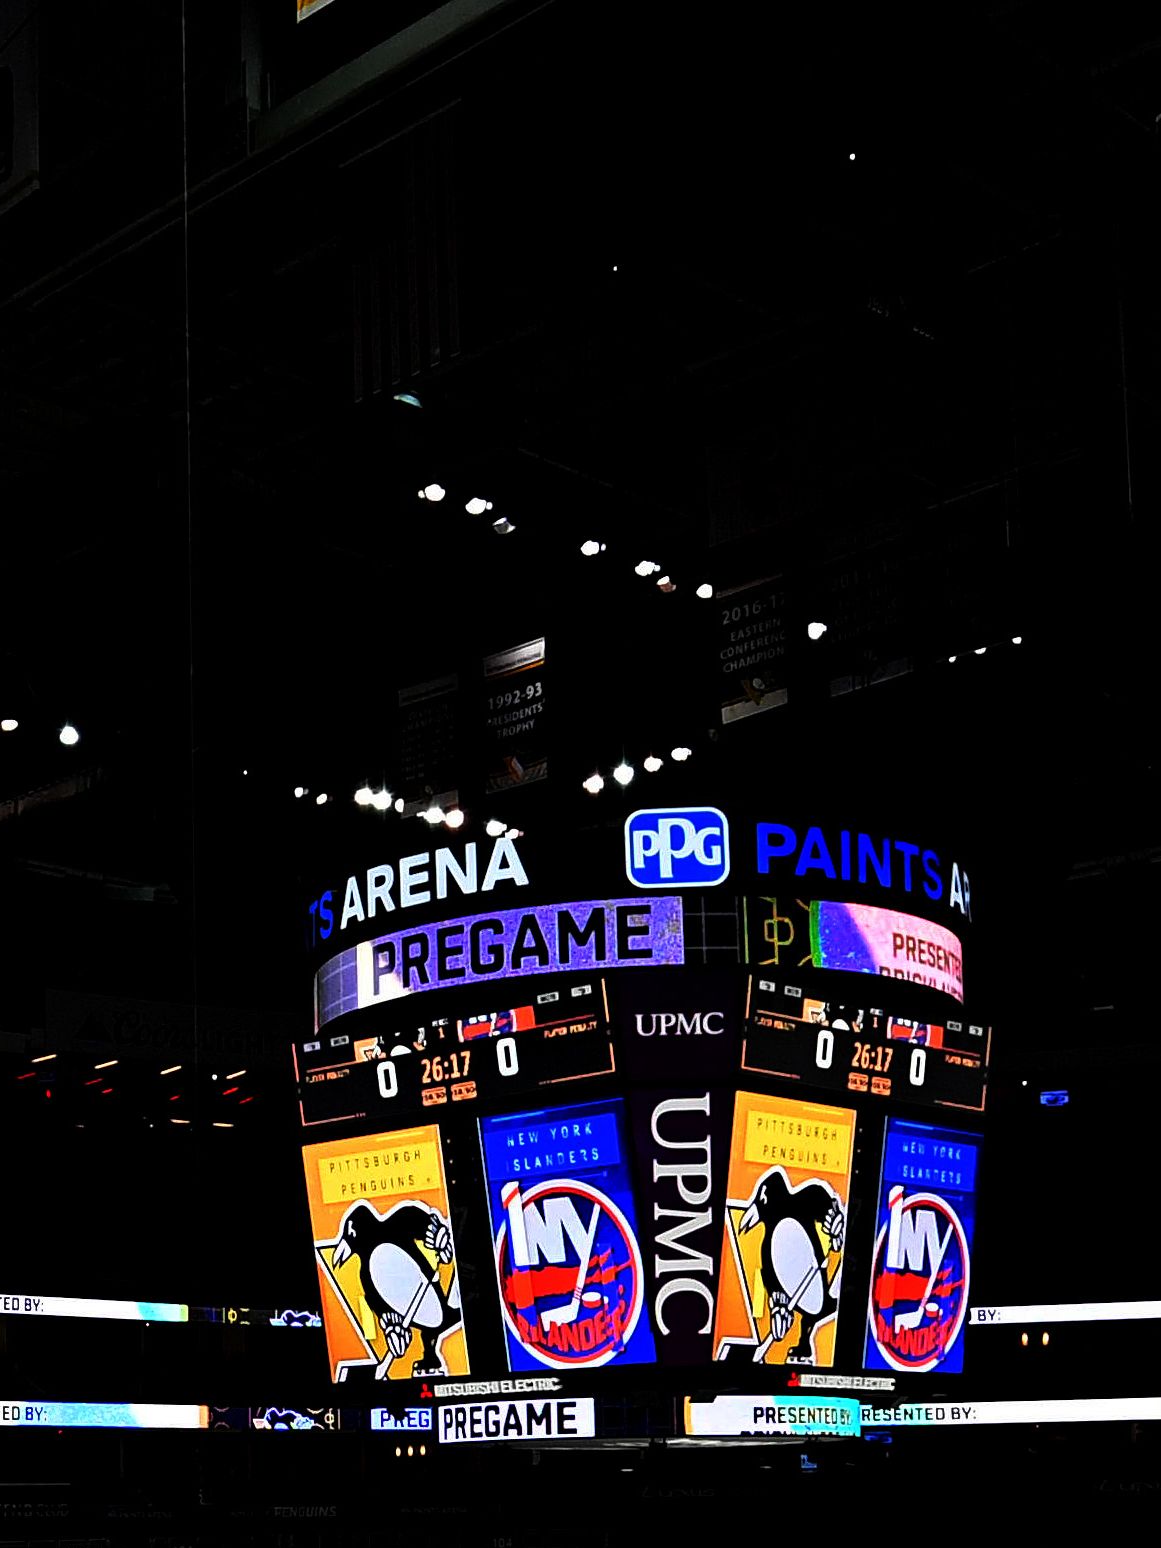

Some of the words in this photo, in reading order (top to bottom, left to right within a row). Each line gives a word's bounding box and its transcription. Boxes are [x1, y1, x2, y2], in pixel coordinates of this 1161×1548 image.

[720, 631, 787, 661] CONFERENC
[488, 682, 543, 710] 1992-93
[632, 819, 723, 879] PPG
[756, 823, 942, 900] PAINTS
[340, 837, 529, 930] ARENA
[372, 904, 653, 996] PREGAME
[633, 1010, 724, 1037] UPMC
[495, 1037, 519, 1077] 0
[816, 1030, 835, 1070] 0
[851, 1041, 894, 1073] 26:17
[376, 1060, 399, 1099] 0
[421, 1051, 472, 1085] 26:17
[909, 1048, 927, 1087] 0
[507, 1131, 539, 1147] NEW
[550, 1123, 593, 1140] YORK
[756, 1118, 838, 1141] PITTSBURGH
[330, 1151, 421, 1174] PITTSBURGH
[763, 1145, 828, 1166] PENGUINS
[933, 1143, 961, 1161] YORK
[341, 1176, 415, 1195] PENGUINS
[651, 1092, 715, 1337] UPMC
[978, 1309, 1001, 1322] BY:
[25, 1406, 47, 1422] BY:
[444, 1401, 578, 1440] PREGAME
[753, 1405, 838, 1426] PRESENTED
[951, 1406, 977, 1421] BY:
